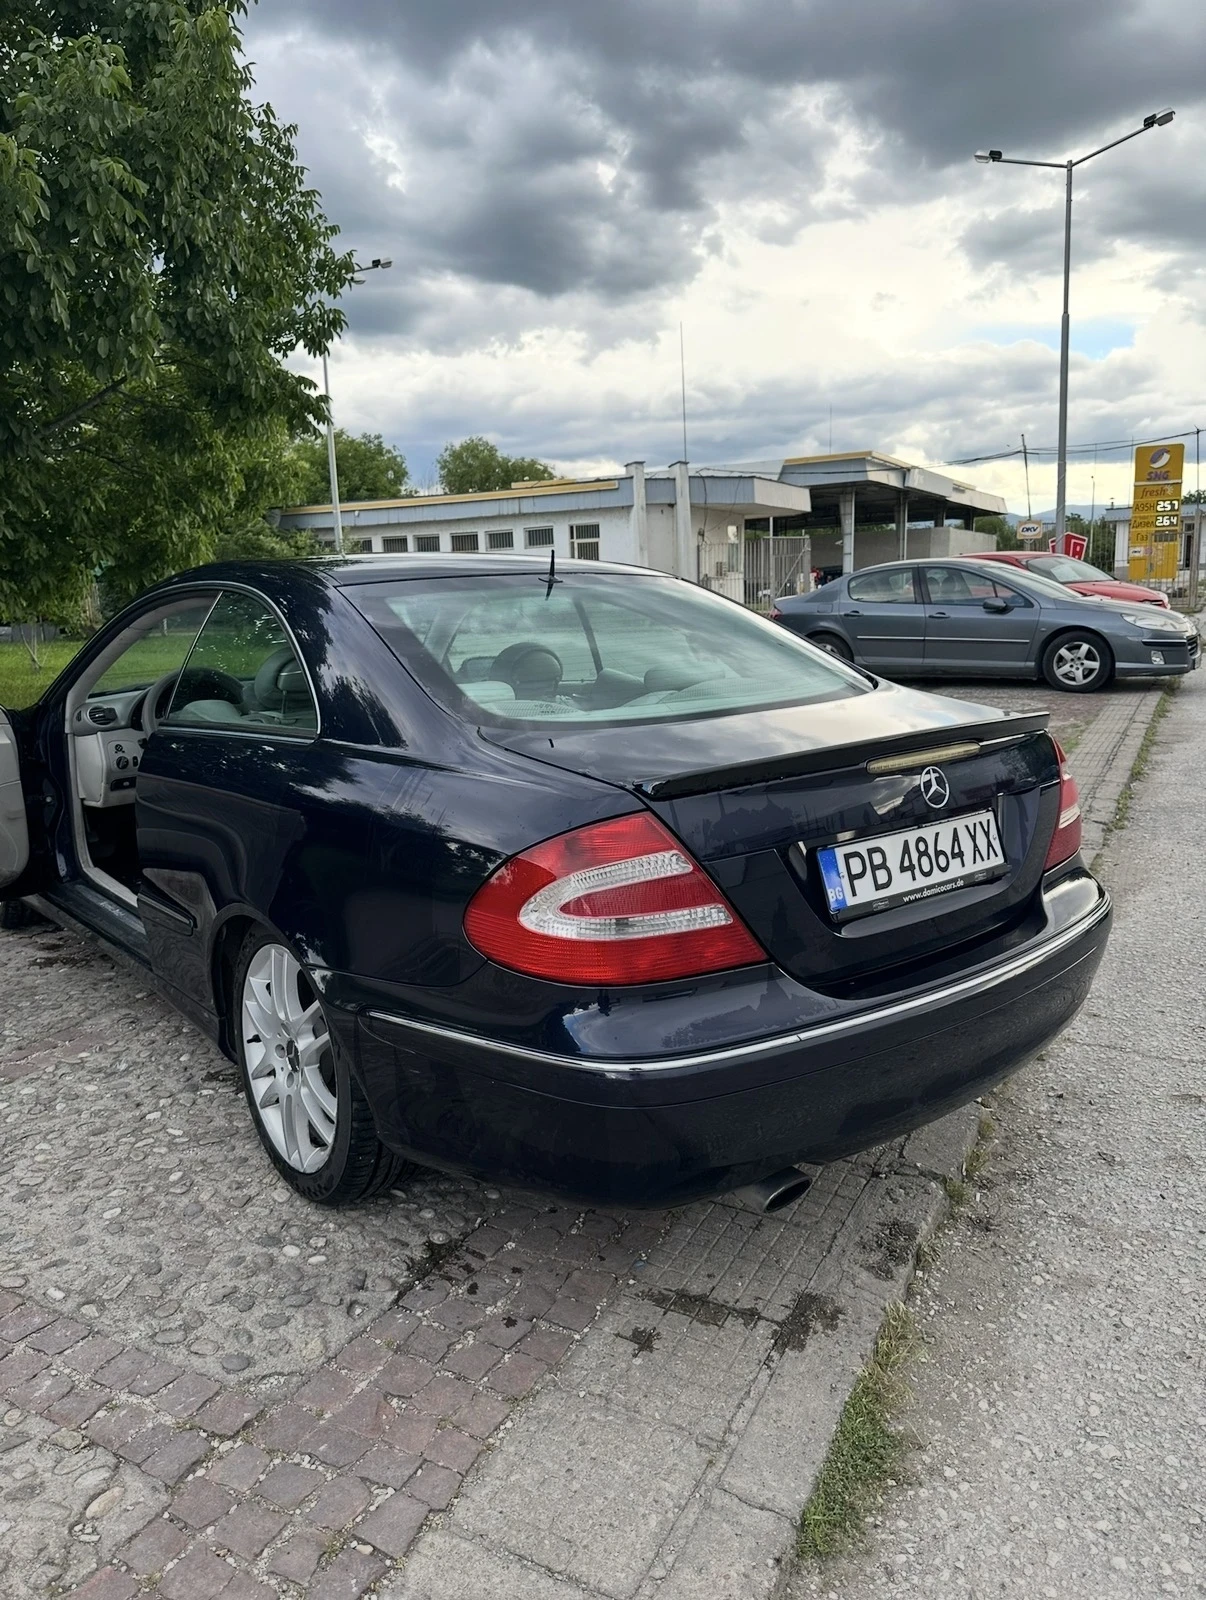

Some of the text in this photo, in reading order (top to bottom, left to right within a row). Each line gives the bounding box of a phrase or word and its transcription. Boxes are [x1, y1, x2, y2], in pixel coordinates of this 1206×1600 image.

[1141, 486, 1166, 499] fresh
[843, 818, 999, 897] PB 4864 XX
[827, 888, 844, 901] BG
[903, 878, 964, 902] www.damicocars.de
